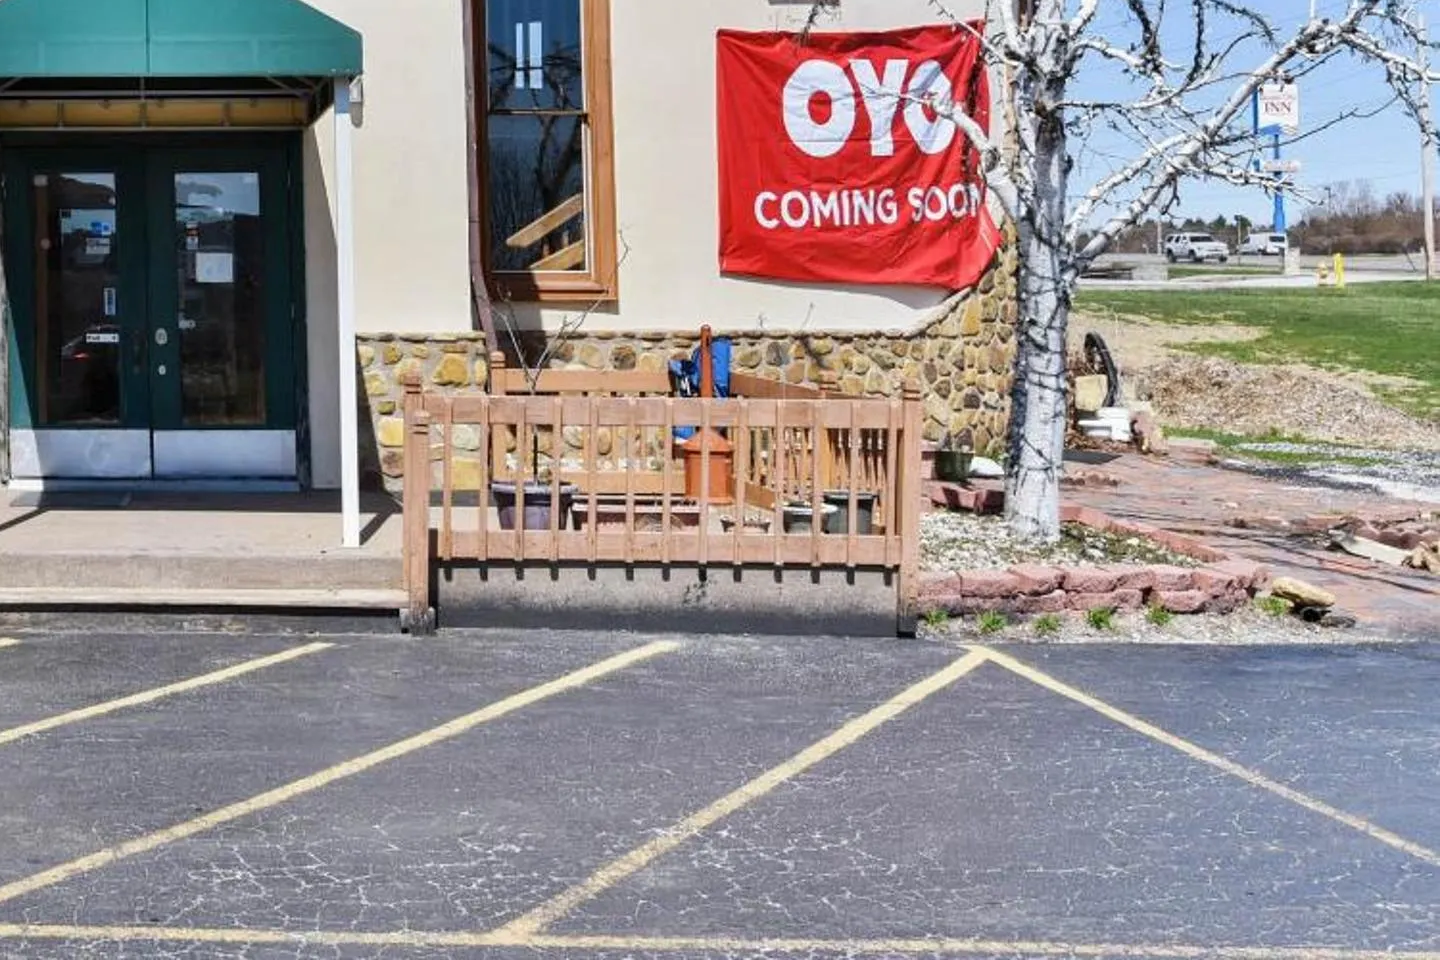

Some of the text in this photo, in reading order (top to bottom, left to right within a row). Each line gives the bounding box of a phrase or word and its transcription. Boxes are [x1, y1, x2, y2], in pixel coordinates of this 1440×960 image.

[782, 58, 957, 158] OYO
[1263, 101, 1292, 113] INN
[754, 188, 898, 229] COMING
